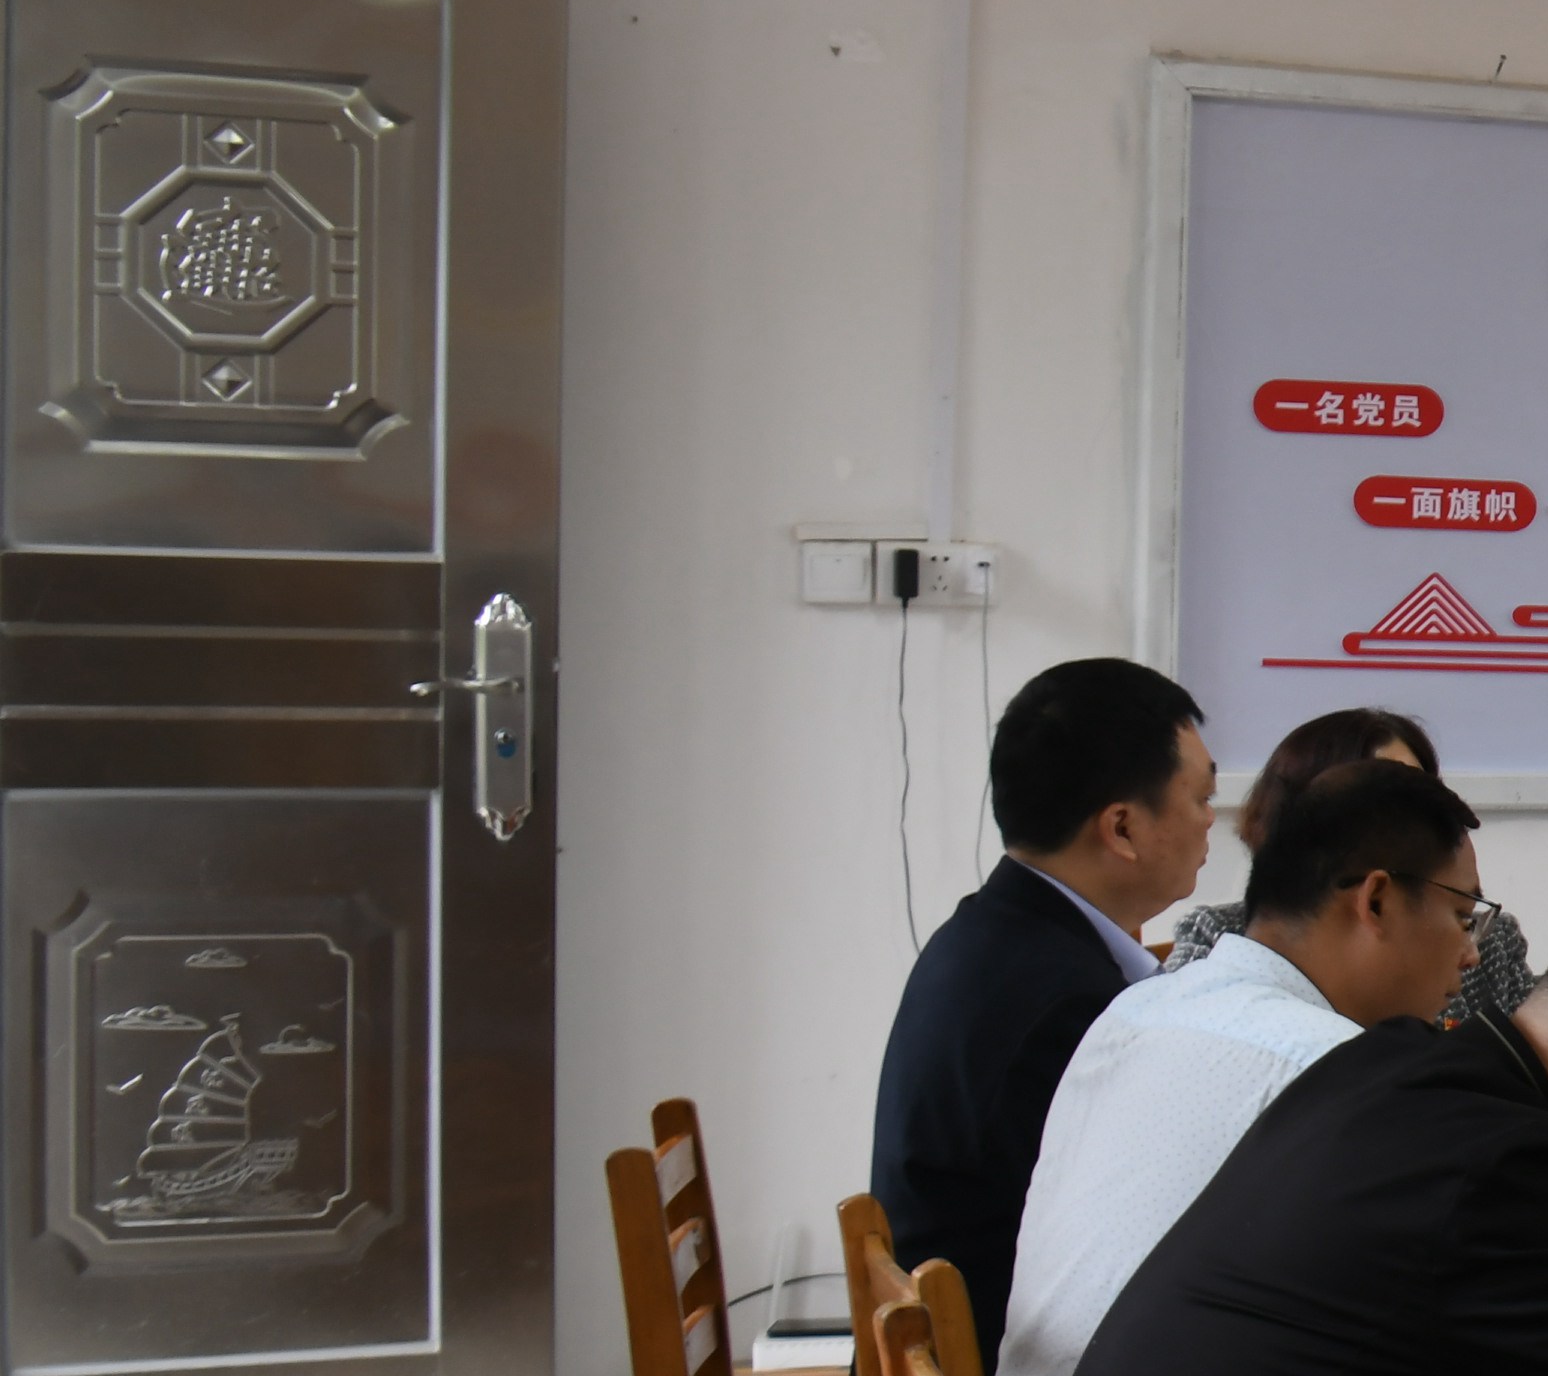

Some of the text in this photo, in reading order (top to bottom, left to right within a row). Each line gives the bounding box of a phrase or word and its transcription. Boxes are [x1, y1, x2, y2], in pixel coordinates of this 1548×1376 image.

[1275, 391, 1422, 428] 一名党员
[1373, 487, 1518, 522] 一面旗帜
